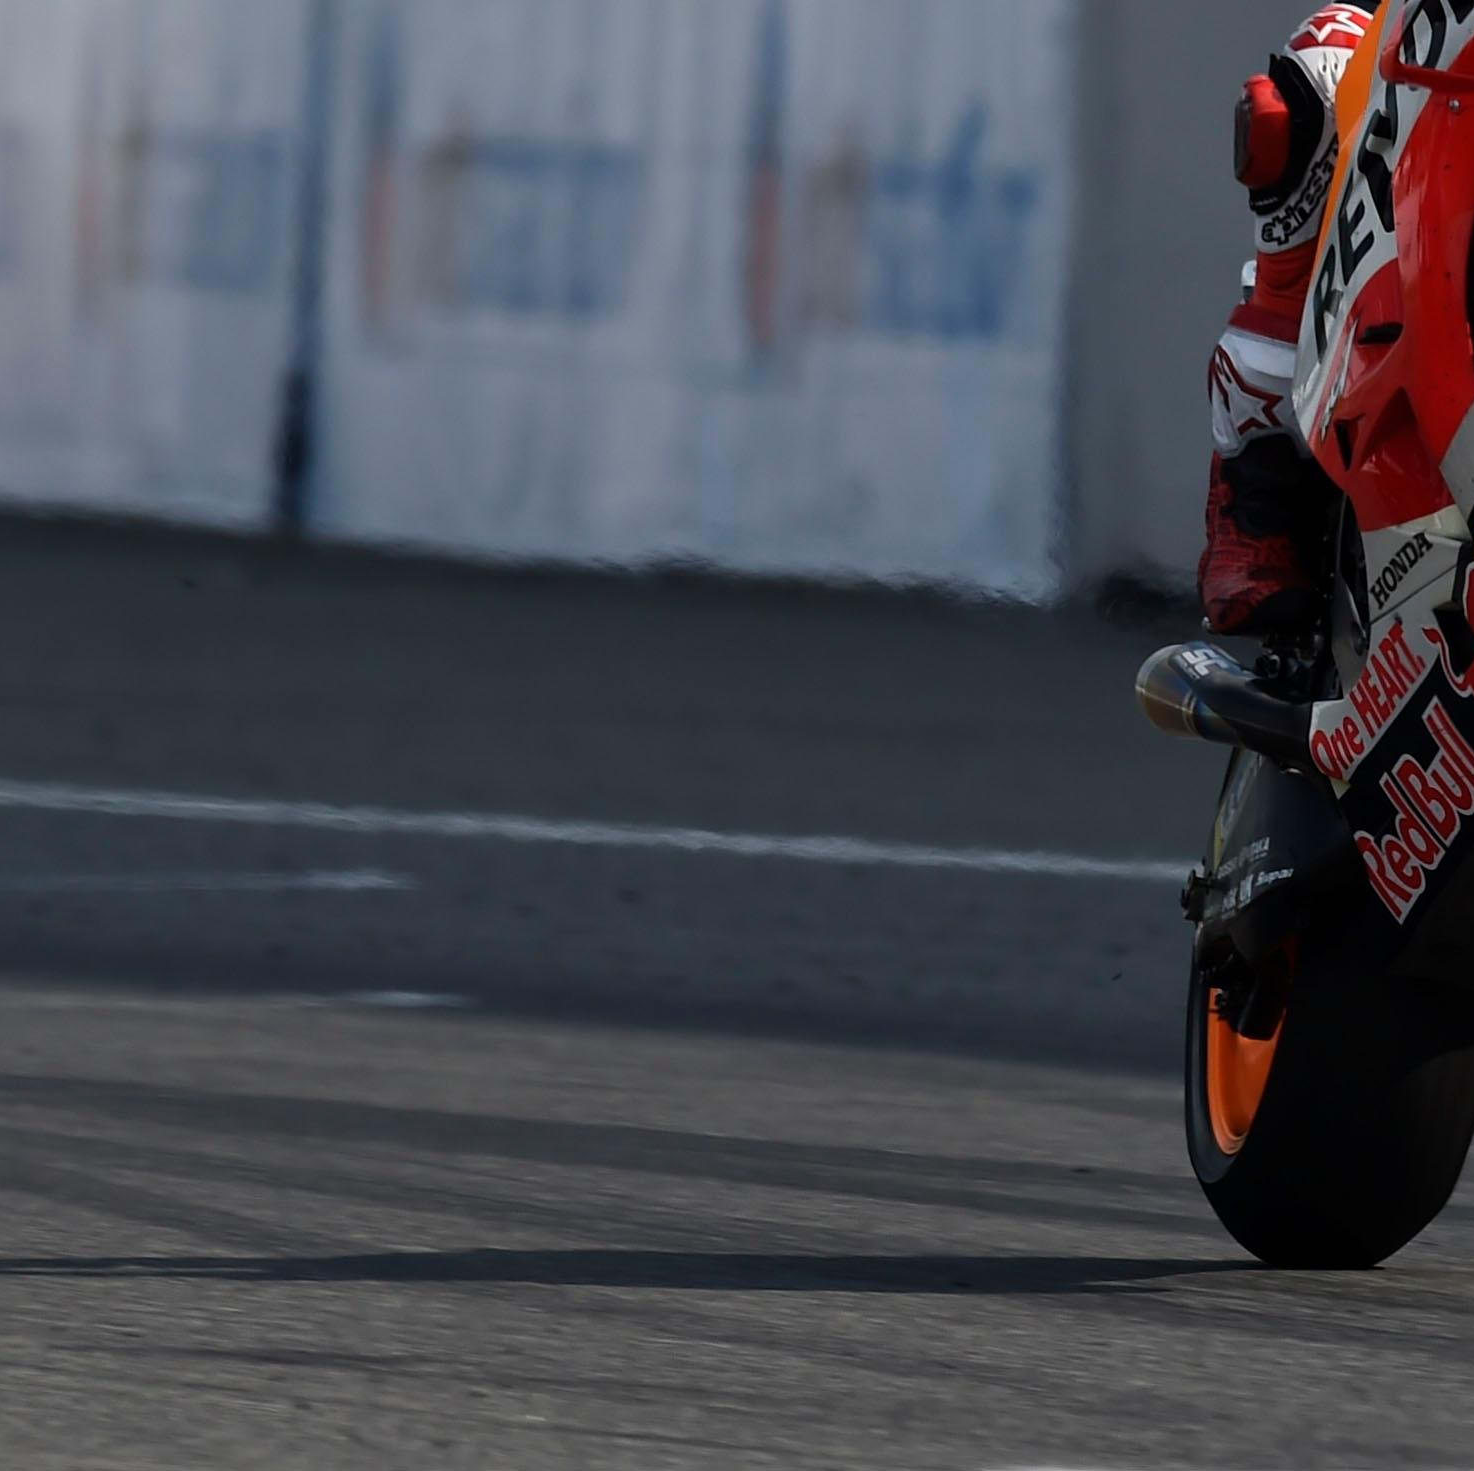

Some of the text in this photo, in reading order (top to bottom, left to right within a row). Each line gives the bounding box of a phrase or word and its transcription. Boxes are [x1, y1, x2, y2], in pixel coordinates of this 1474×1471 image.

[1369, 532, 1433, 611] HONDA
[1310, 716, 1366, 782] One
[1353, 771, 1446, 926] Red
